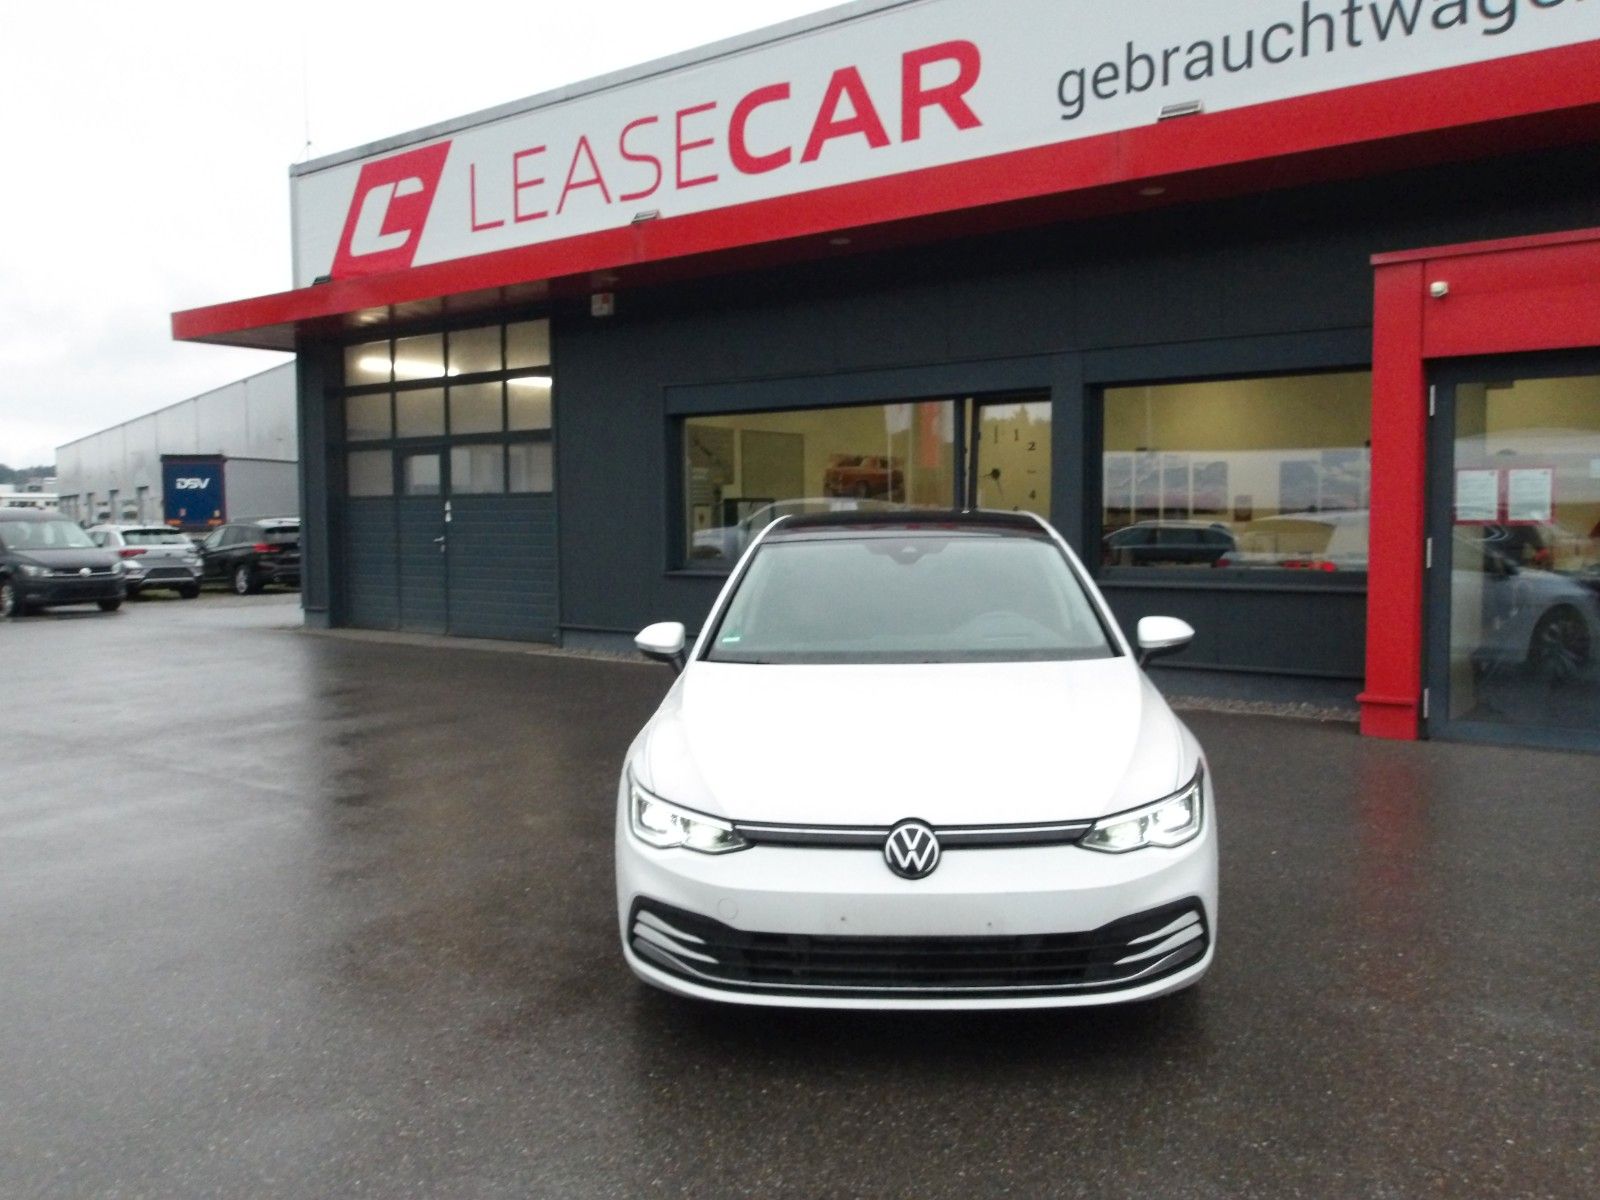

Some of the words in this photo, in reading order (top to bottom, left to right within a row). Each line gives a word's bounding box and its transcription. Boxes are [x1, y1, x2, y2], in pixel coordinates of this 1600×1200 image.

[1056, 0, 1600, 120] gebrauchtwag
[470, 39, 983, 233] LEASECAR
[175, 477, 210, 489] DSV
